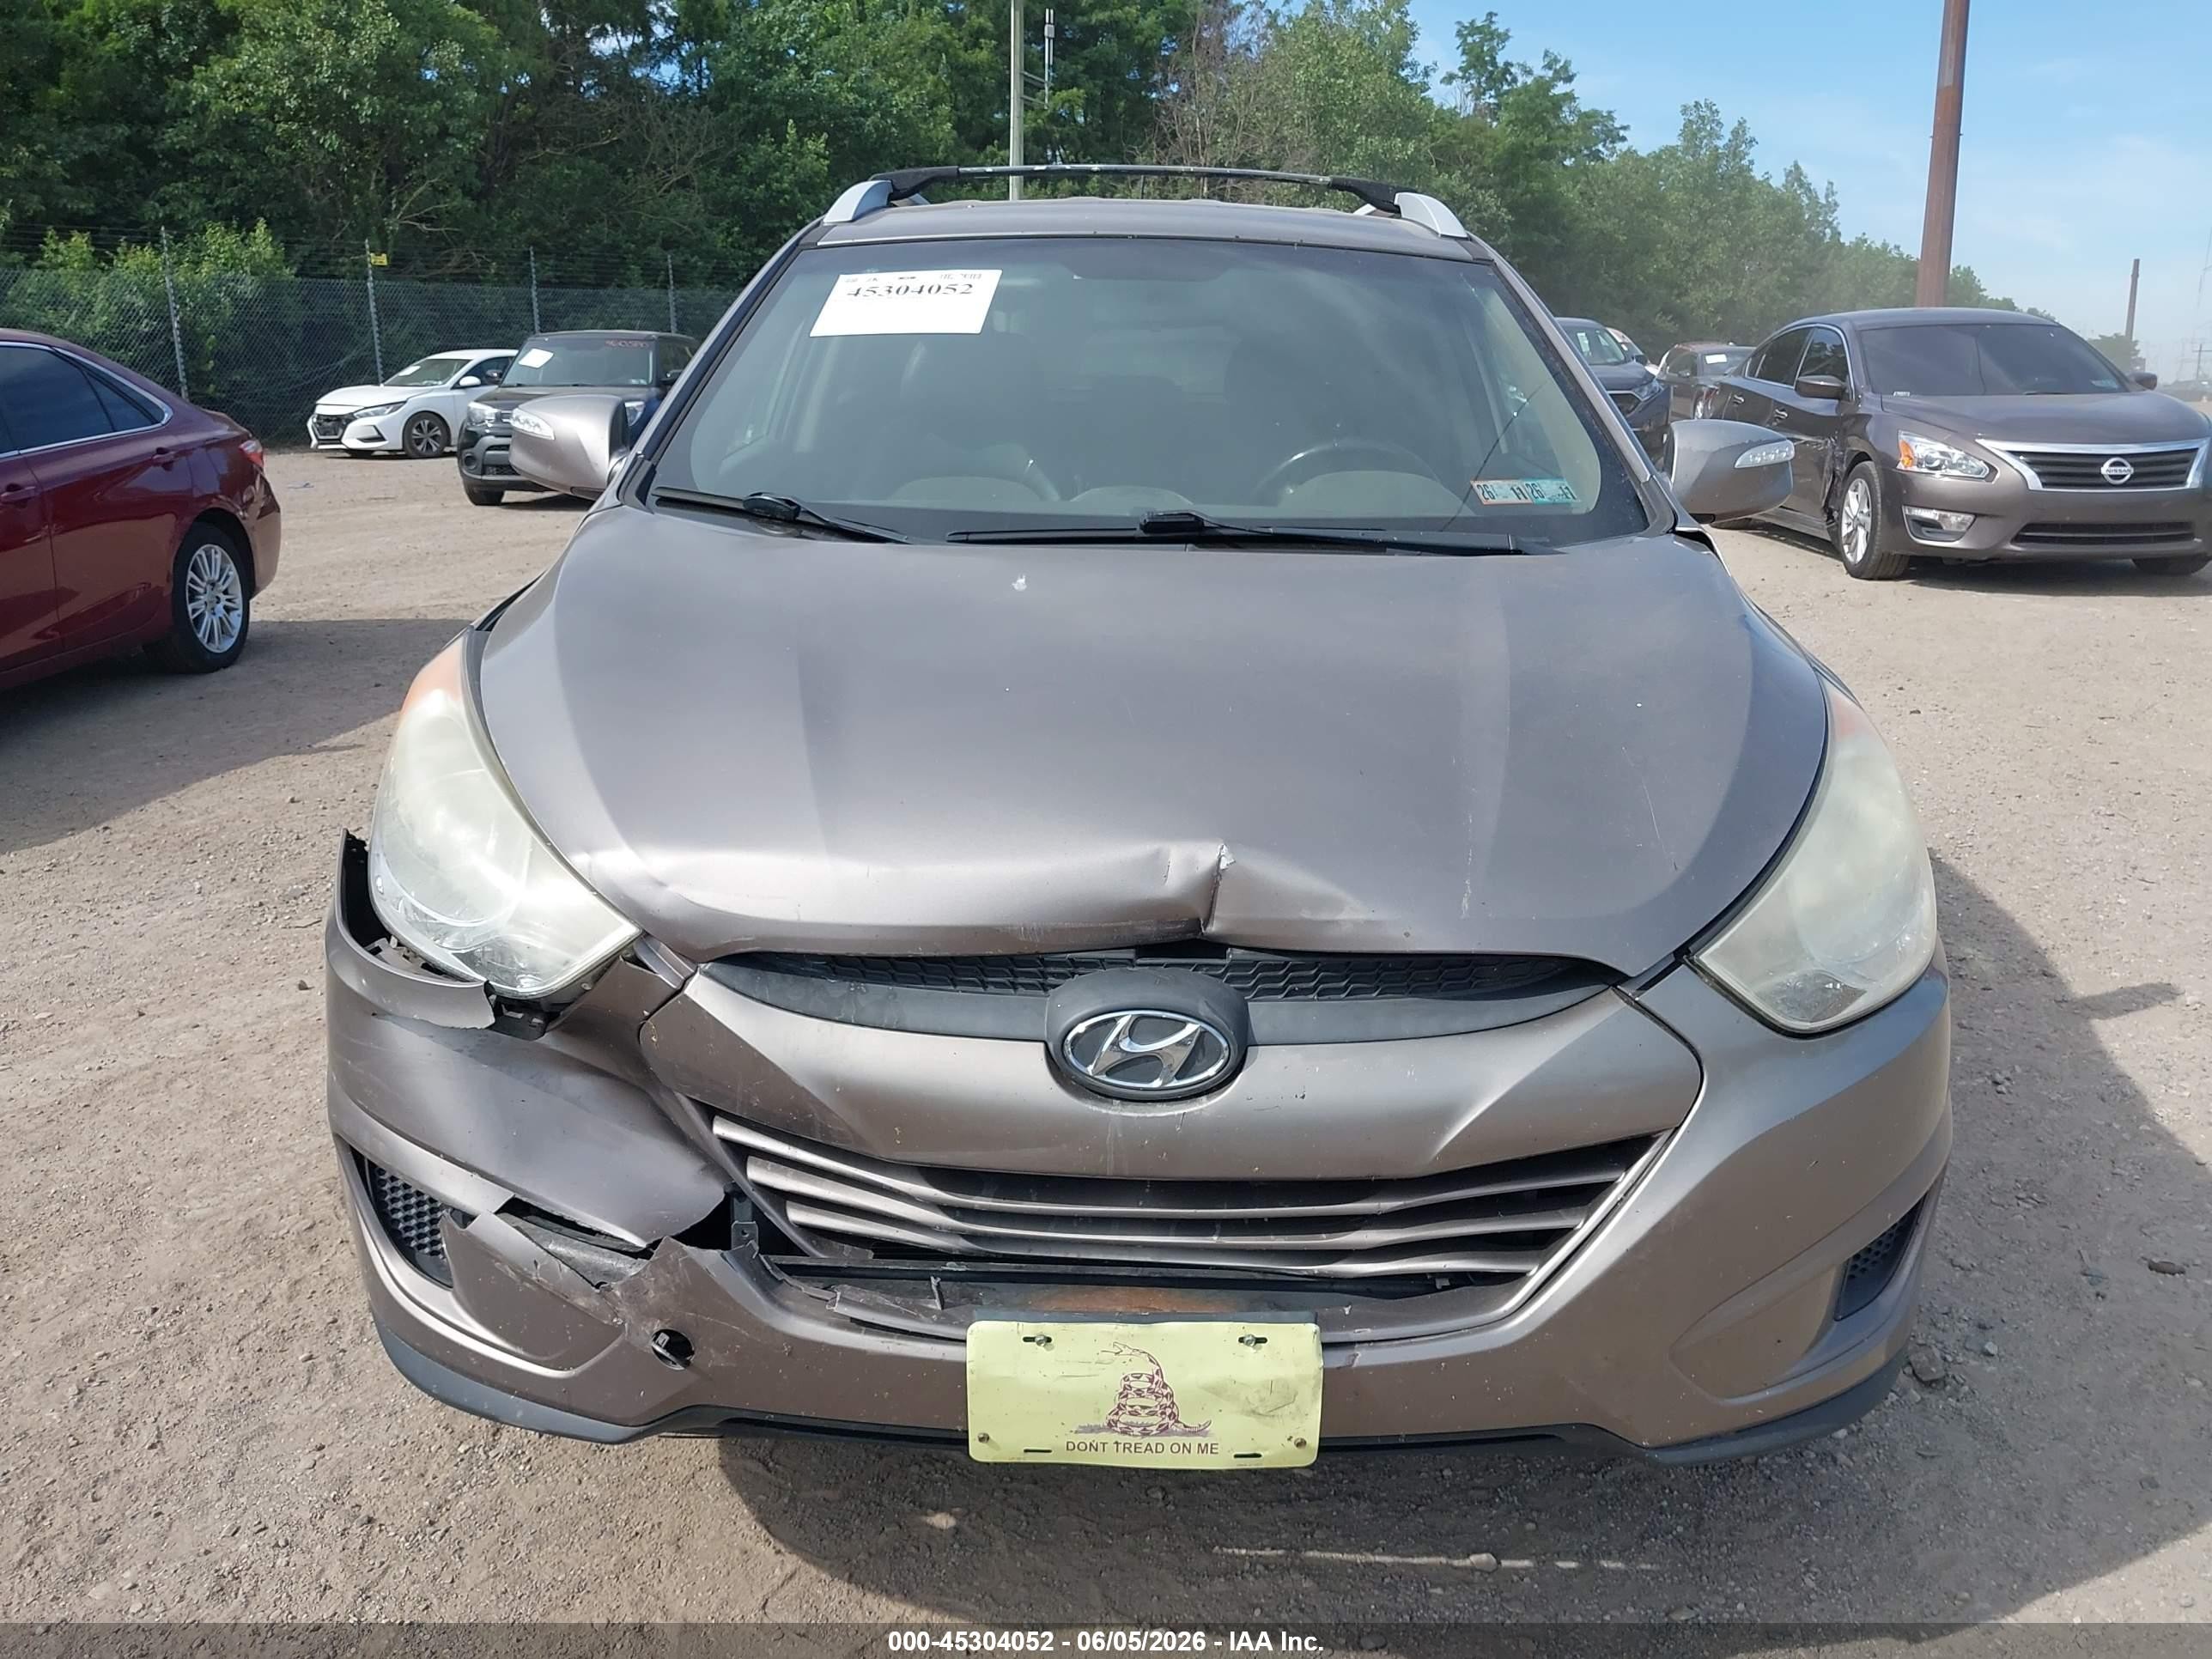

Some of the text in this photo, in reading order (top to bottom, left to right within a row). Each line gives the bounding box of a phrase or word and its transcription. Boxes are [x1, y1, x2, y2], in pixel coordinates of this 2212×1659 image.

[847, 283, 973, 297] 45304052
[1477, 483, 1496, 500] 26
[1525, 483, 1545, 499] 26
[1066, 1441, 1219, 1455] DONT TREAD ON ME
